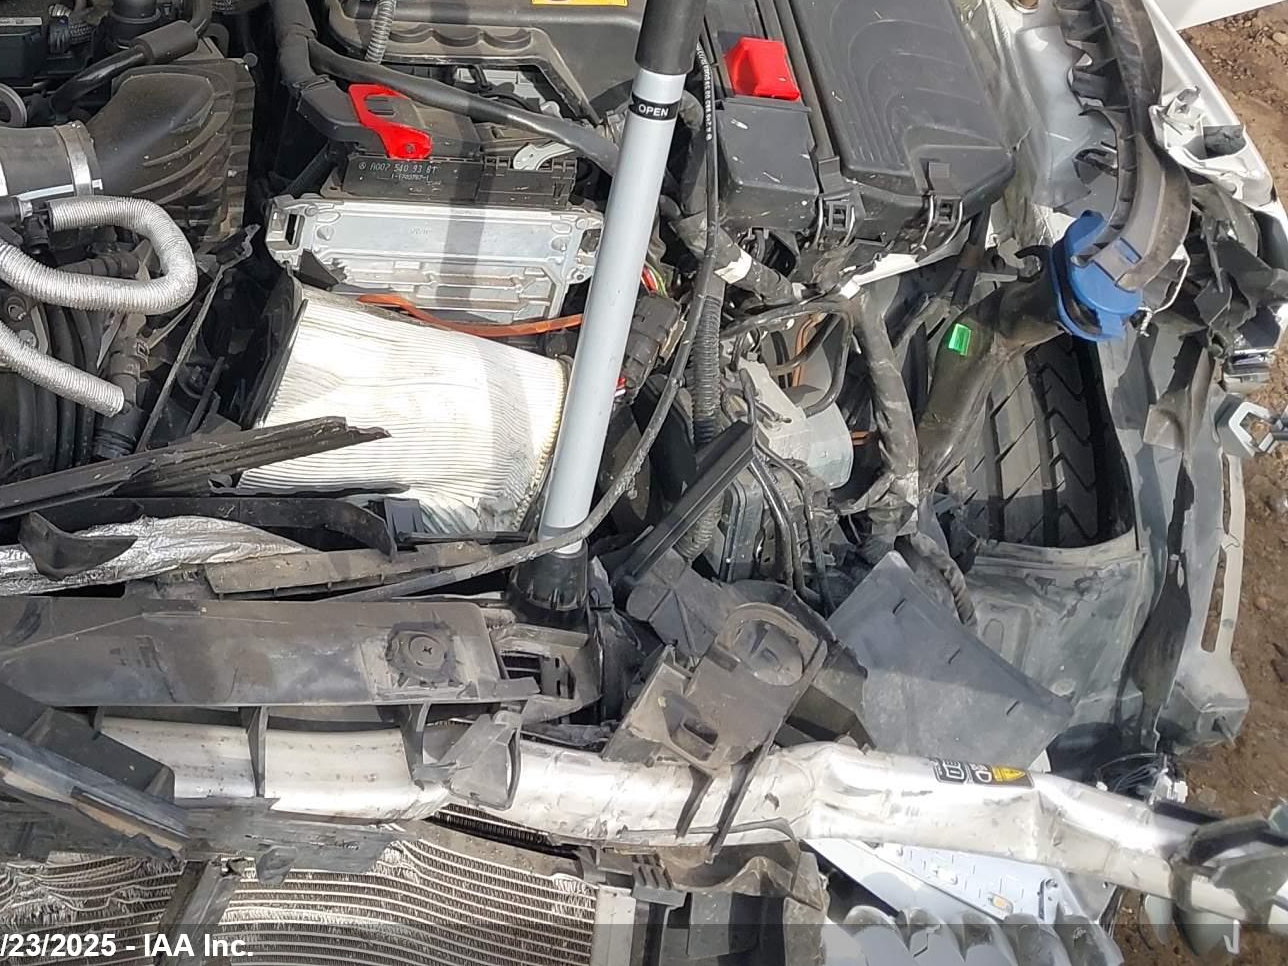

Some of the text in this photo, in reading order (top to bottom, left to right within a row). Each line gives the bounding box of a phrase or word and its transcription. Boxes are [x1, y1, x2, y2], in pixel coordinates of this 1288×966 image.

[638, 103, 669, 117] OPEN
[393, 162, 409, 173] 540
[411, 163, 423, 174] 93
